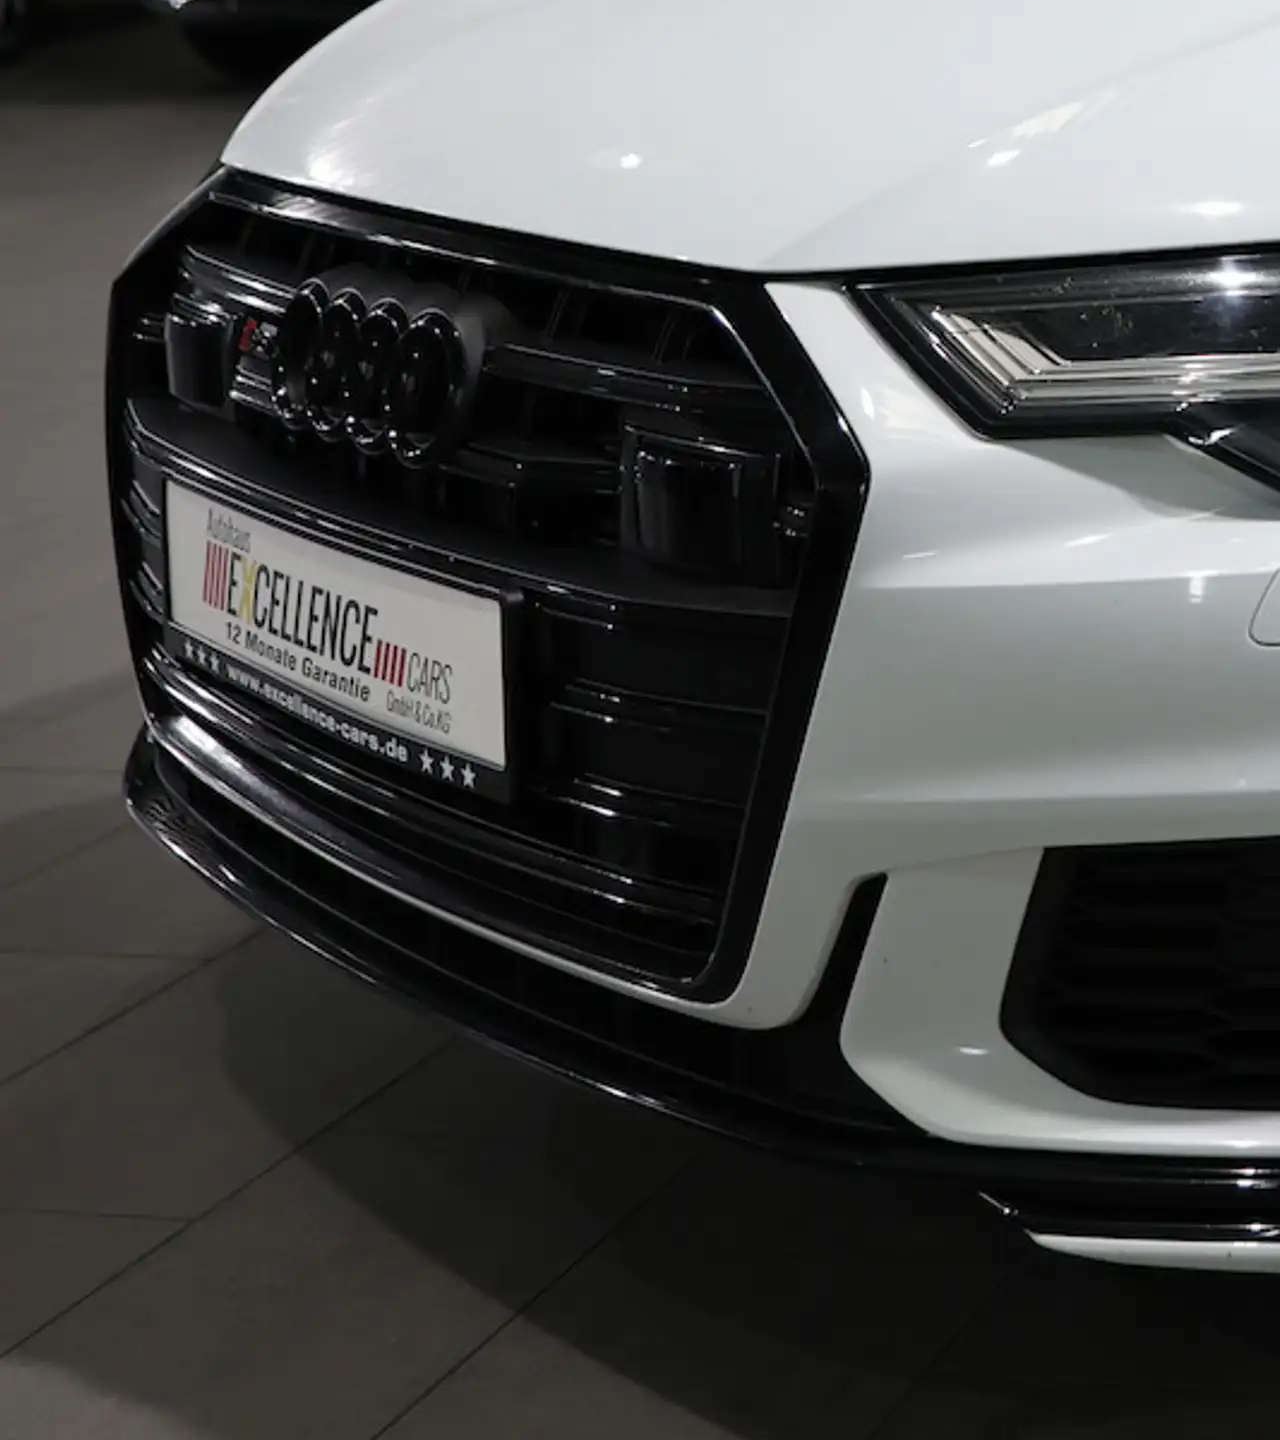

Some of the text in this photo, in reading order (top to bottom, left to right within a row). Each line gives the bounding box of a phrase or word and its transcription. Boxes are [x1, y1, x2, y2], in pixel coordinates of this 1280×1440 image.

[226, 552, 453, 705] EXCELLENCE CARS
[226, 621, 372, 703] 12 Monate Garantie
[225, 666, 409, 763] www.excellence-cars.de
